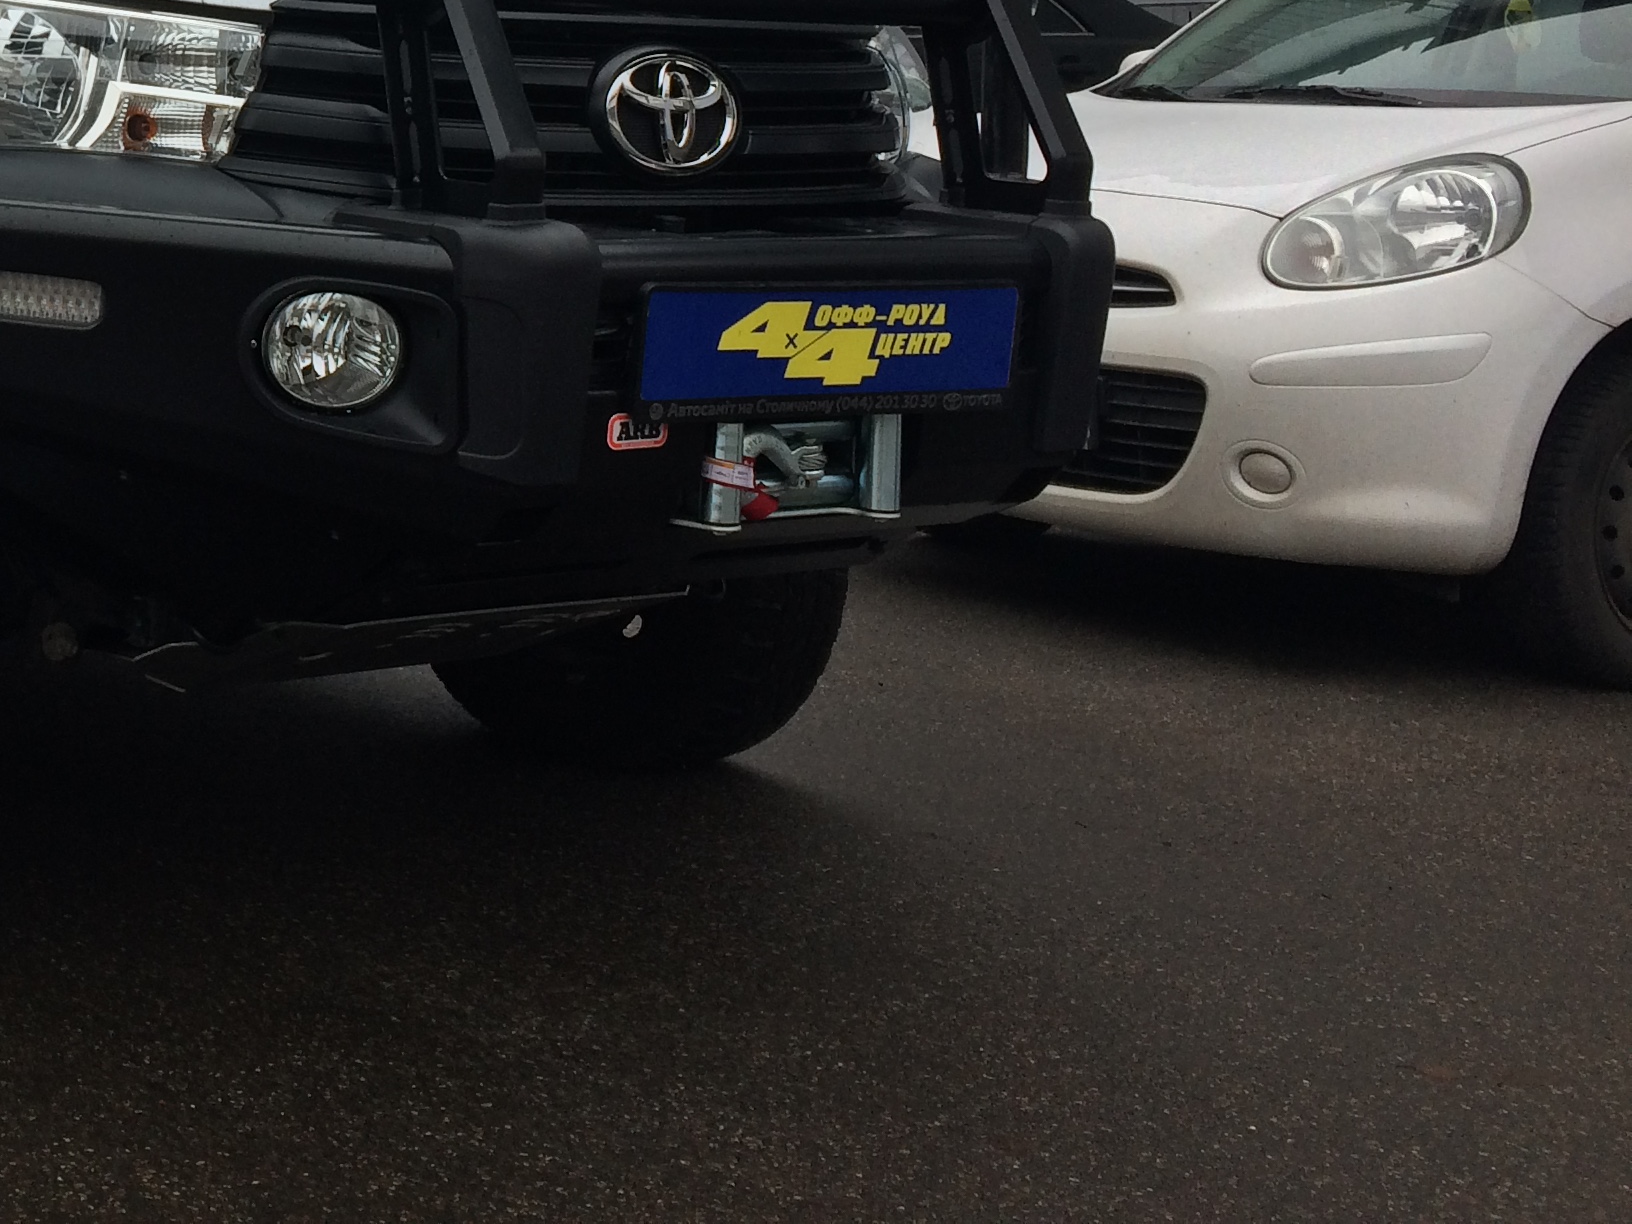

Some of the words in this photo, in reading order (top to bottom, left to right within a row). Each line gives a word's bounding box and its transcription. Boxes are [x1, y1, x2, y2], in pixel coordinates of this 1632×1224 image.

[814, 303, 946, 327] ОФФ-РОУД
[875, 332, 952, 358] ЦЕНТР
[739, 403, 754, 415] на
[756, 398, 835, 415] Столичному
[836, 396, 873, 414] (044)
[875, 395, 900, 410] 201
[902, 395, 918, 409] 30
[920, 394, 938, 408] 30
[963, 393, 1003, 407] TOYOTA
